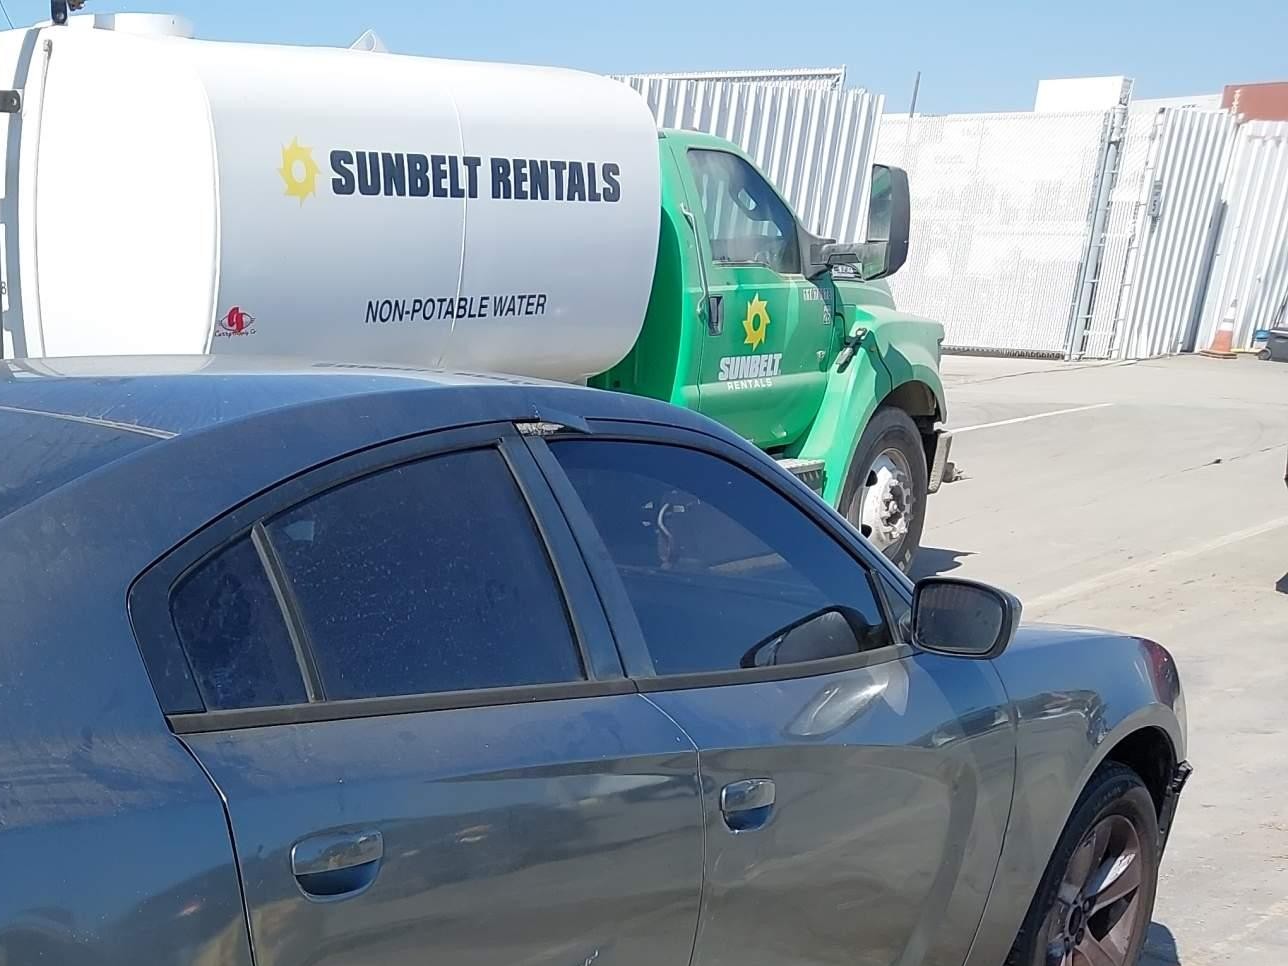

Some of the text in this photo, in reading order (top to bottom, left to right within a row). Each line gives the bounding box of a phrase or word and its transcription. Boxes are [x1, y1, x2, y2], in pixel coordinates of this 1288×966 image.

[329, 150, 621, 203] SUNBELT RENTALS
[365, 293, 547, 324] NON-POTABLE WATER
[718, 353, 783, 380] SUNBELT
[727, 378, 773, 391] RENTALS
